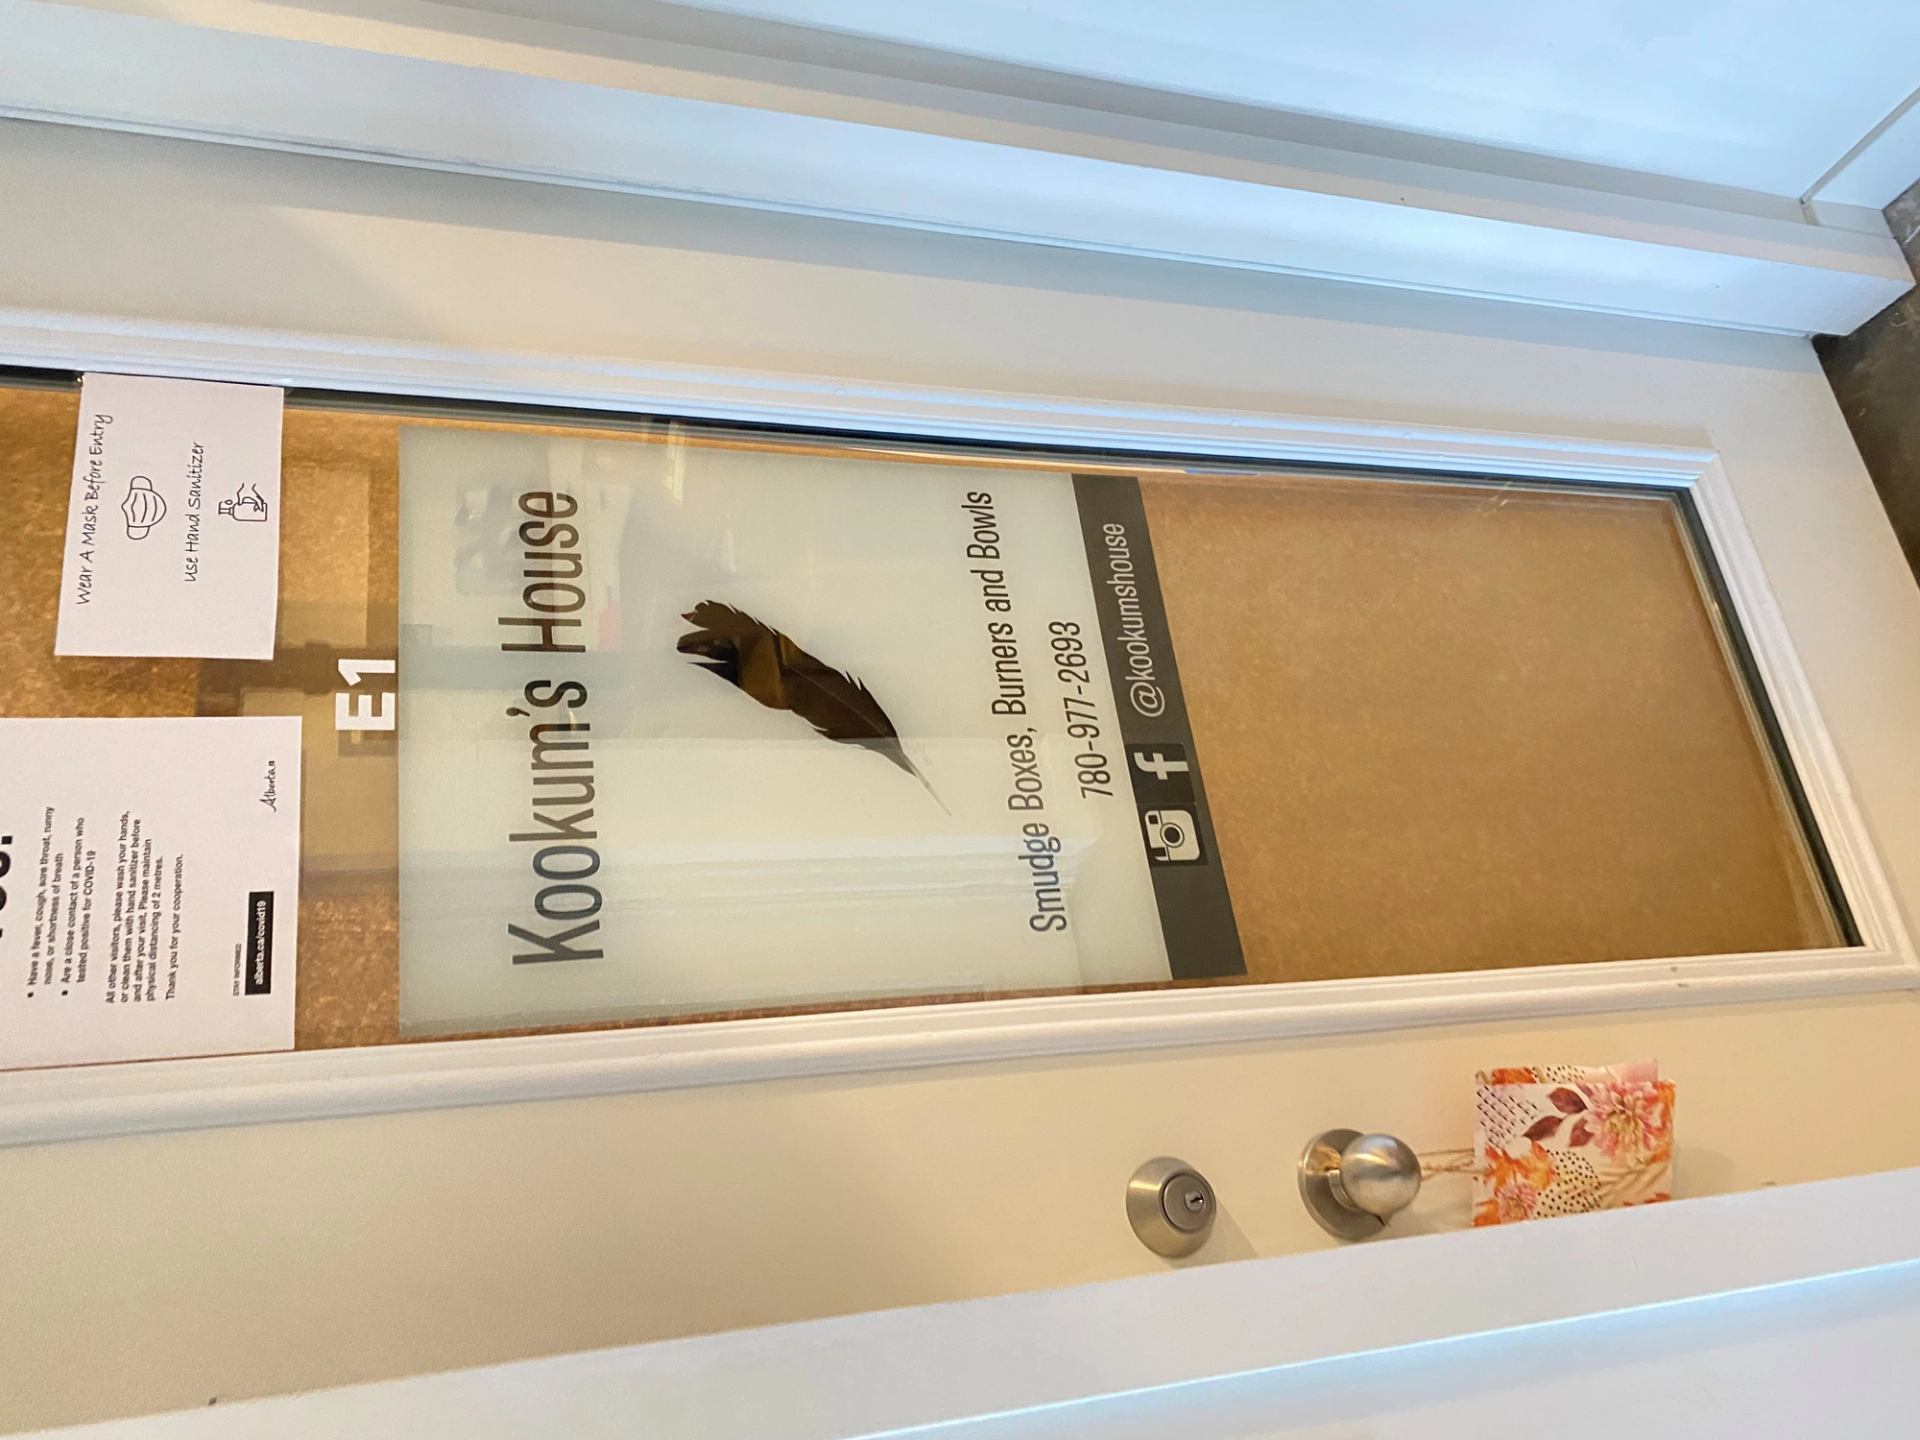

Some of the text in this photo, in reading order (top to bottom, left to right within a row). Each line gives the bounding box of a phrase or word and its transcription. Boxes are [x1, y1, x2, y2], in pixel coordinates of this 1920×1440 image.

[76, 414, 113, 604] Wear A Mask Before Entry
[184, 442, 204, 582] Use Hand Sanitizer
[1101, 523, 1165, 717] @kookumshouse
[335, 659, 396, 730] E1
[961, 491, 1066, 932] Smudge Boxes, Burners and Bowls
[1048, 620, 1114, 799] 780-977-2693
[499, 491, 603, 965] Kookum's House
[43, 807, 54, 832] runny
[74, 818, 84, 836] who
[40, 836, 51, 864] throat,
[72, 839, 83, 870] person
[38, 867, 47, 886] sore
[70, 880, 78, 889] of
[154, 856, 162, 889] metres.
[35, 889, 47, 921] cough,
[44, 853, 63, 984] nose, or shortness of breath
[67, 892, 78, 927] contact
[77, 851, 95, 982] tested positive for COVID-19
[106, 811, 129, 1003] All other visitors, please wash your hands,
[120, 819, 141, 1002] or clean them with hand sanitizer before
[133, 839, 151, 1001] and after your visit. Please maintain
[151, 900, 160, 909] of
[31, 923, 43, 949] fever,
[63, 930, 74, 955] close
[149, 912, 161, 960] distancing
[166, 854, 183, 999] Thank you for your cooperation.
[254, 901, 266, 985] alberta.ca/covid19
[27, 961, 39, 985] Have
[61, 967, 71, 983] Are
[146, 962, 156, 1001] physical
